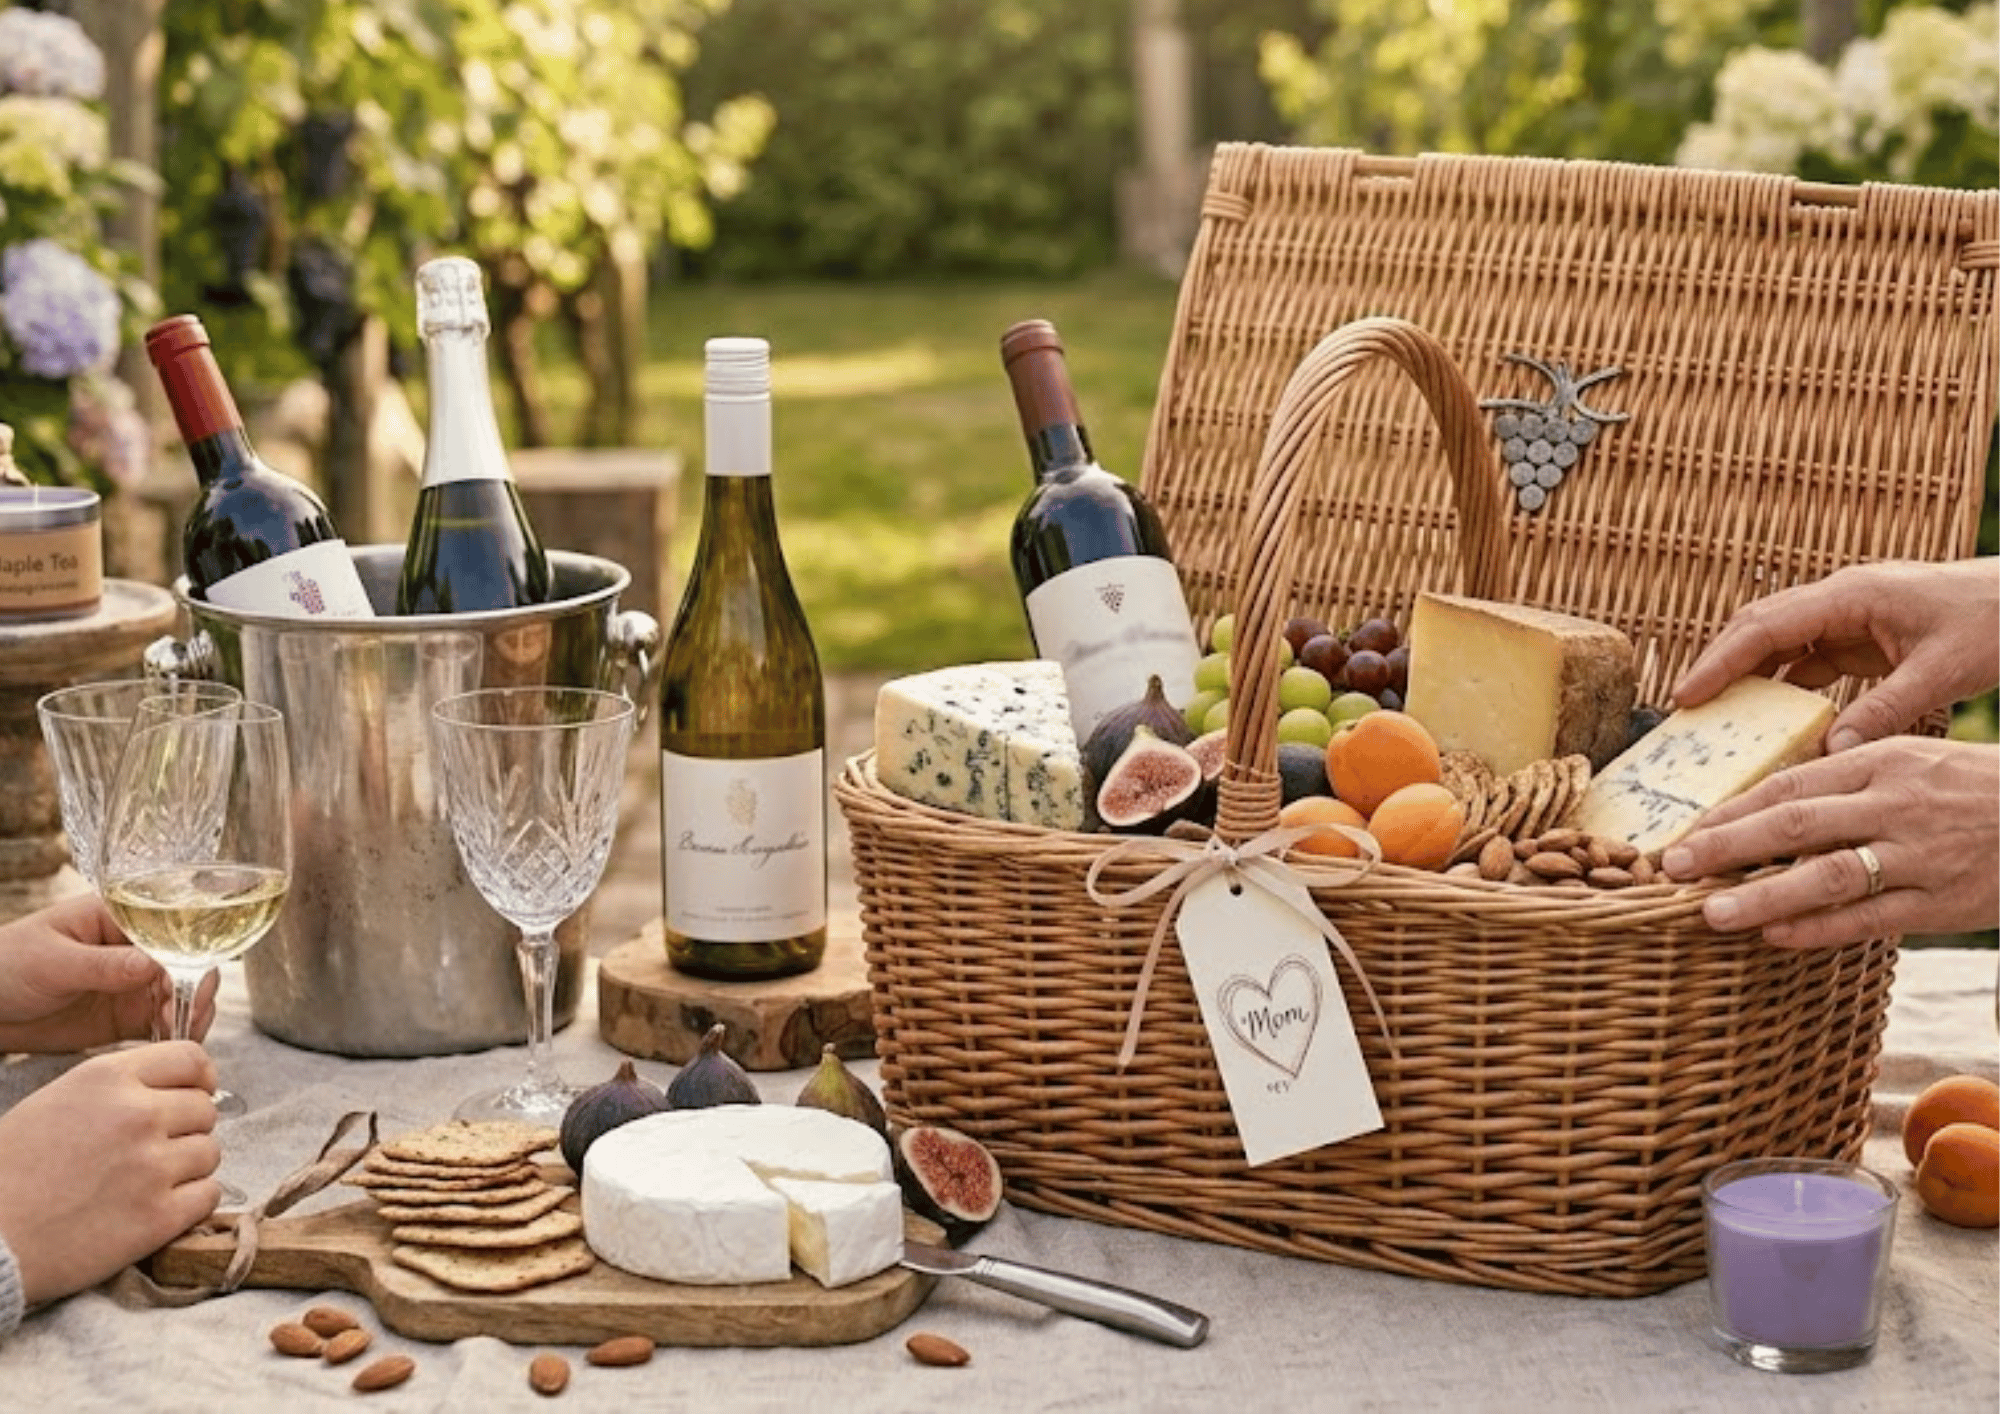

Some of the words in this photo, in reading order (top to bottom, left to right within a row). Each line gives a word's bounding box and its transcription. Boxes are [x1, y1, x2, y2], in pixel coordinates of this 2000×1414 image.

[0, 555, 43, 577] aple
[50, 552, 78, 571] Tea
[1243, 1006, 1309, 1040] Mom
